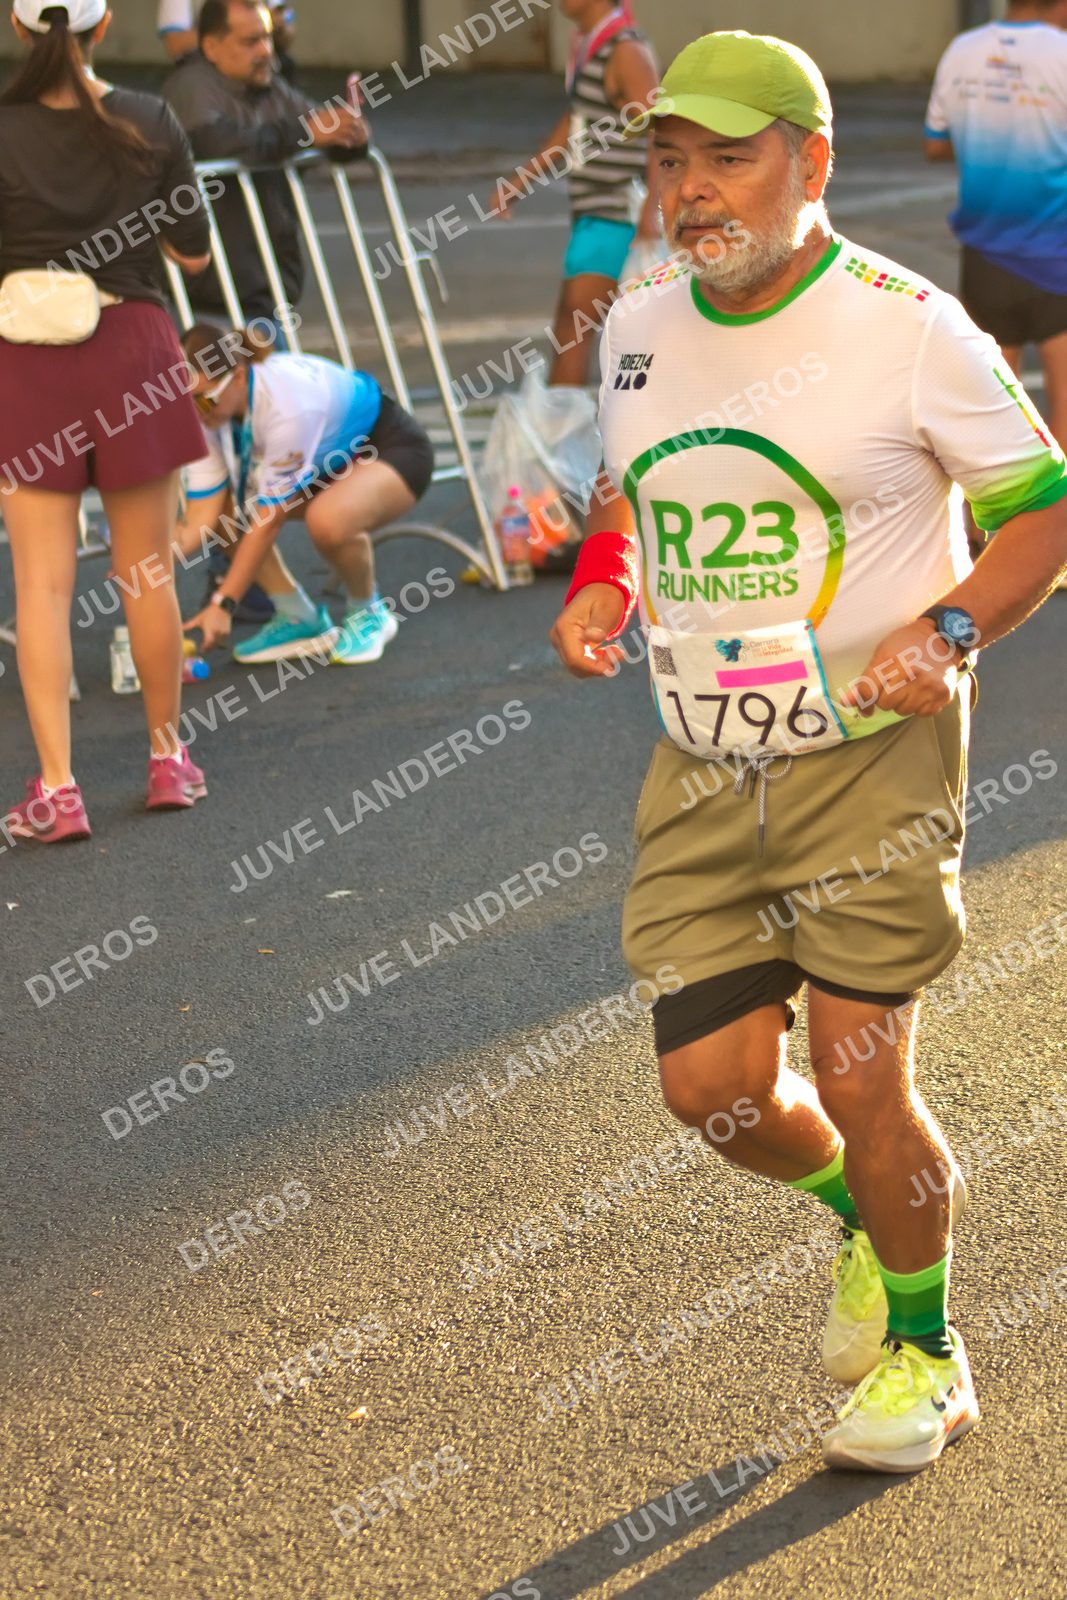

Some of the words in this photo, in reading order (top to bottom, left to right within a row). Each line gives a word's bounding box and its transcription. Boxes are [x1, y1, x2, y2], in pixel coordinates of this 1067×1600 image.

[650, 500, 799, 569] R23
[658, 567, 799, 603] RUNNERS
[667, 686, 828, 747] 1796
